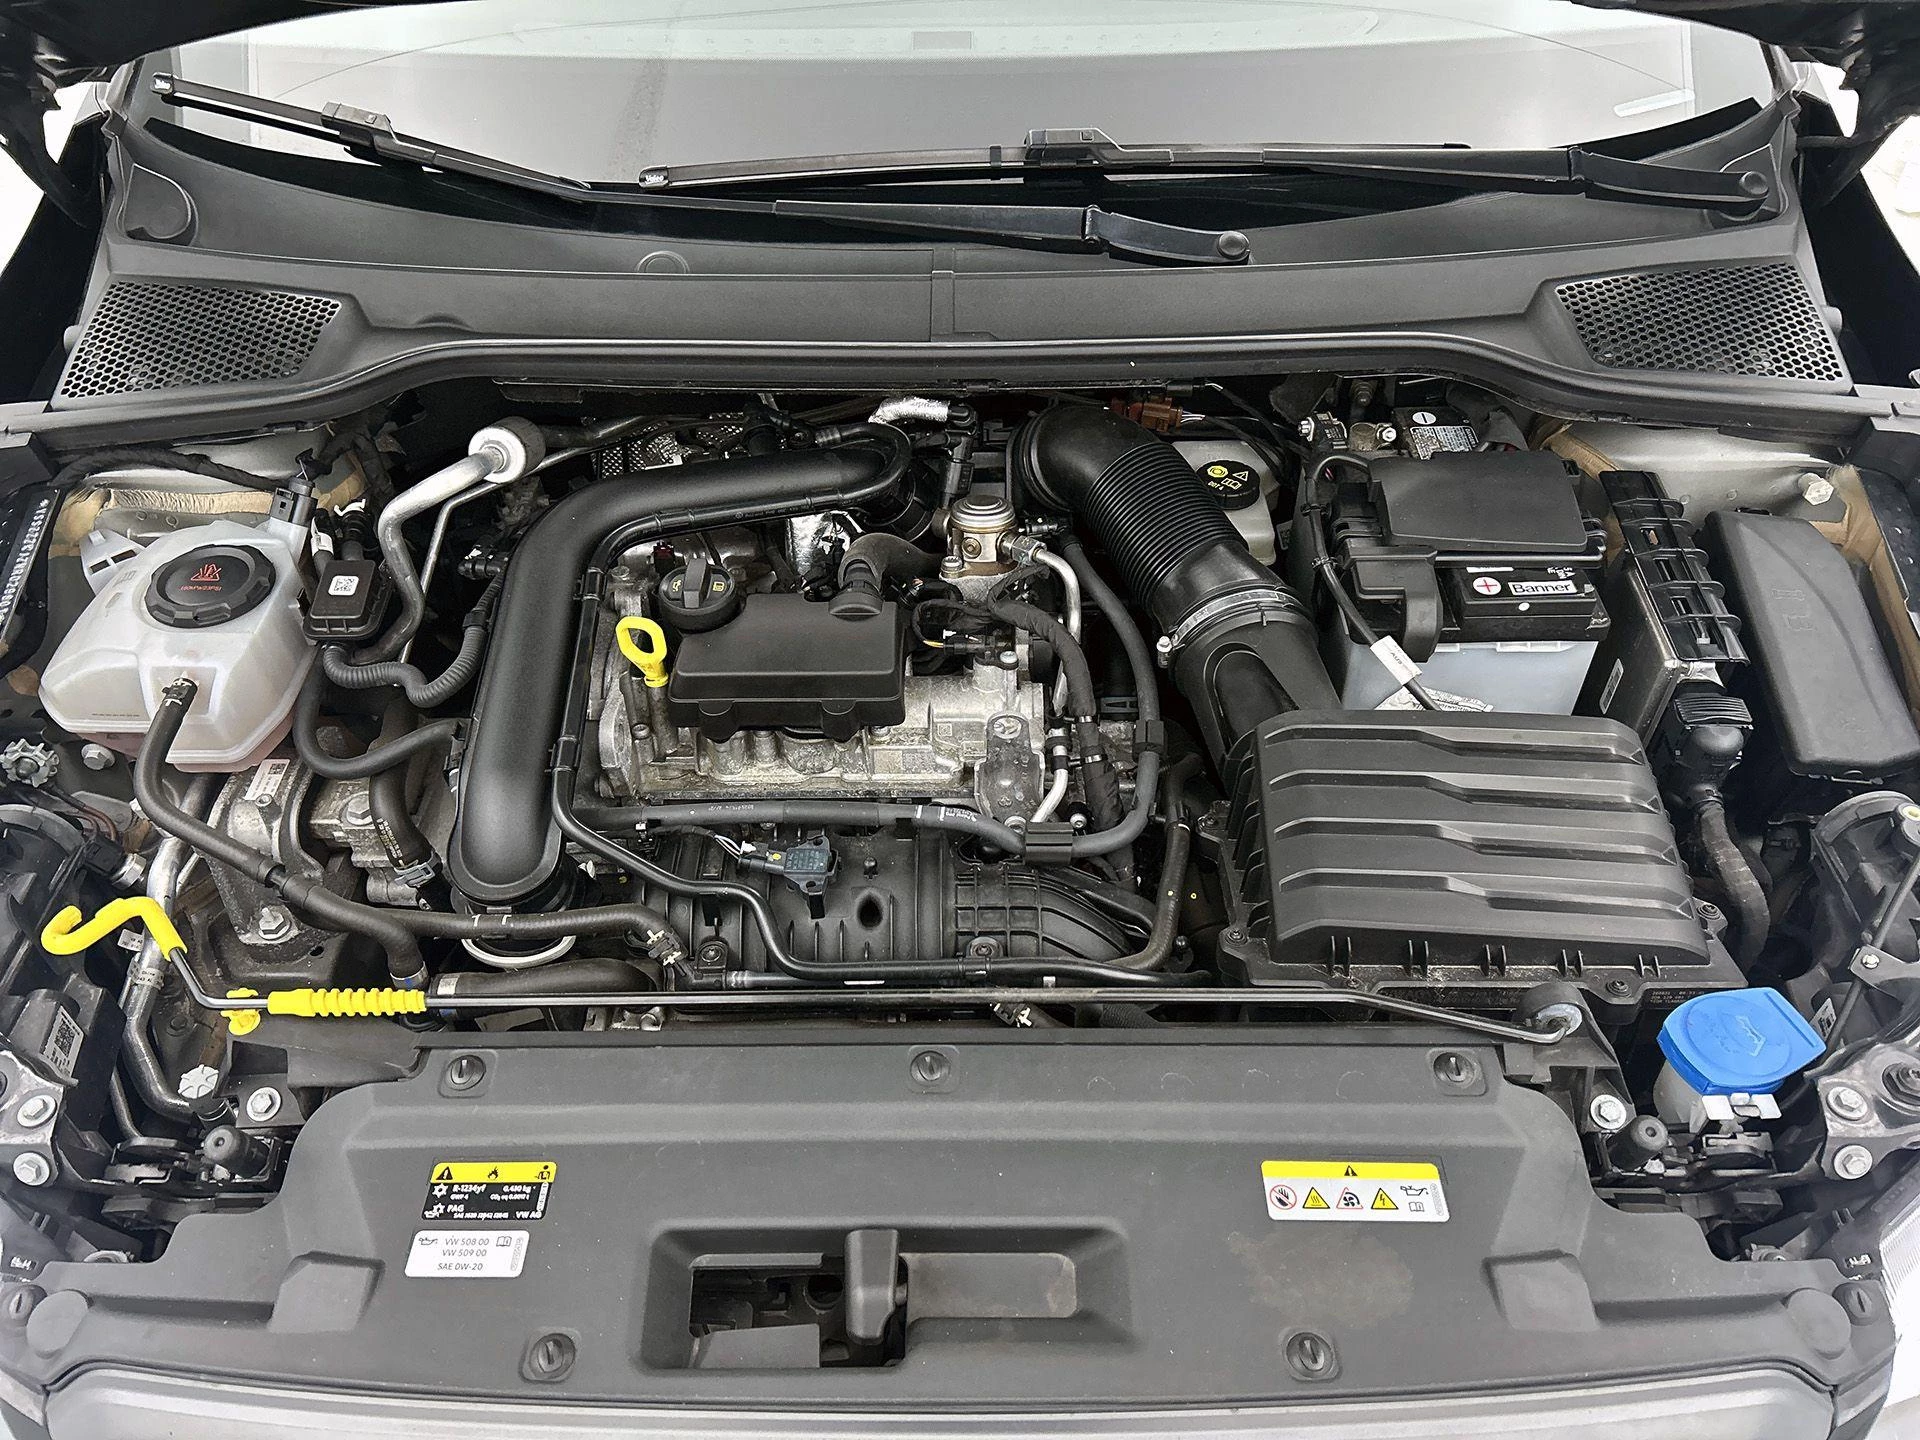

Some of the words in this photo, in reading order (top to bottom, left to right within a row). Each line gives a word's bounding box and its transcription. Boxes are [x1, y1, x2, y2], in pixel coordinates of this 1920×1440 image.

[1512, 583, 1571, 594] Banner
[447, 1204, 465, 1212] PAG
[516, 1211, 529, 1219] VW
[445, 1238, 459, 1246] VW
[461, 1238, 477, 1246] 508
[478, 1238, 490, 1246] 00
[442, 1249, 457, 1257] VW
[458, 1249, 474, 1257] 509
[475, 1249, 487, 1257] 00
[438, 1262, 454, 1271] SAE
[454, 1262, 484, 1271] 0W-20
